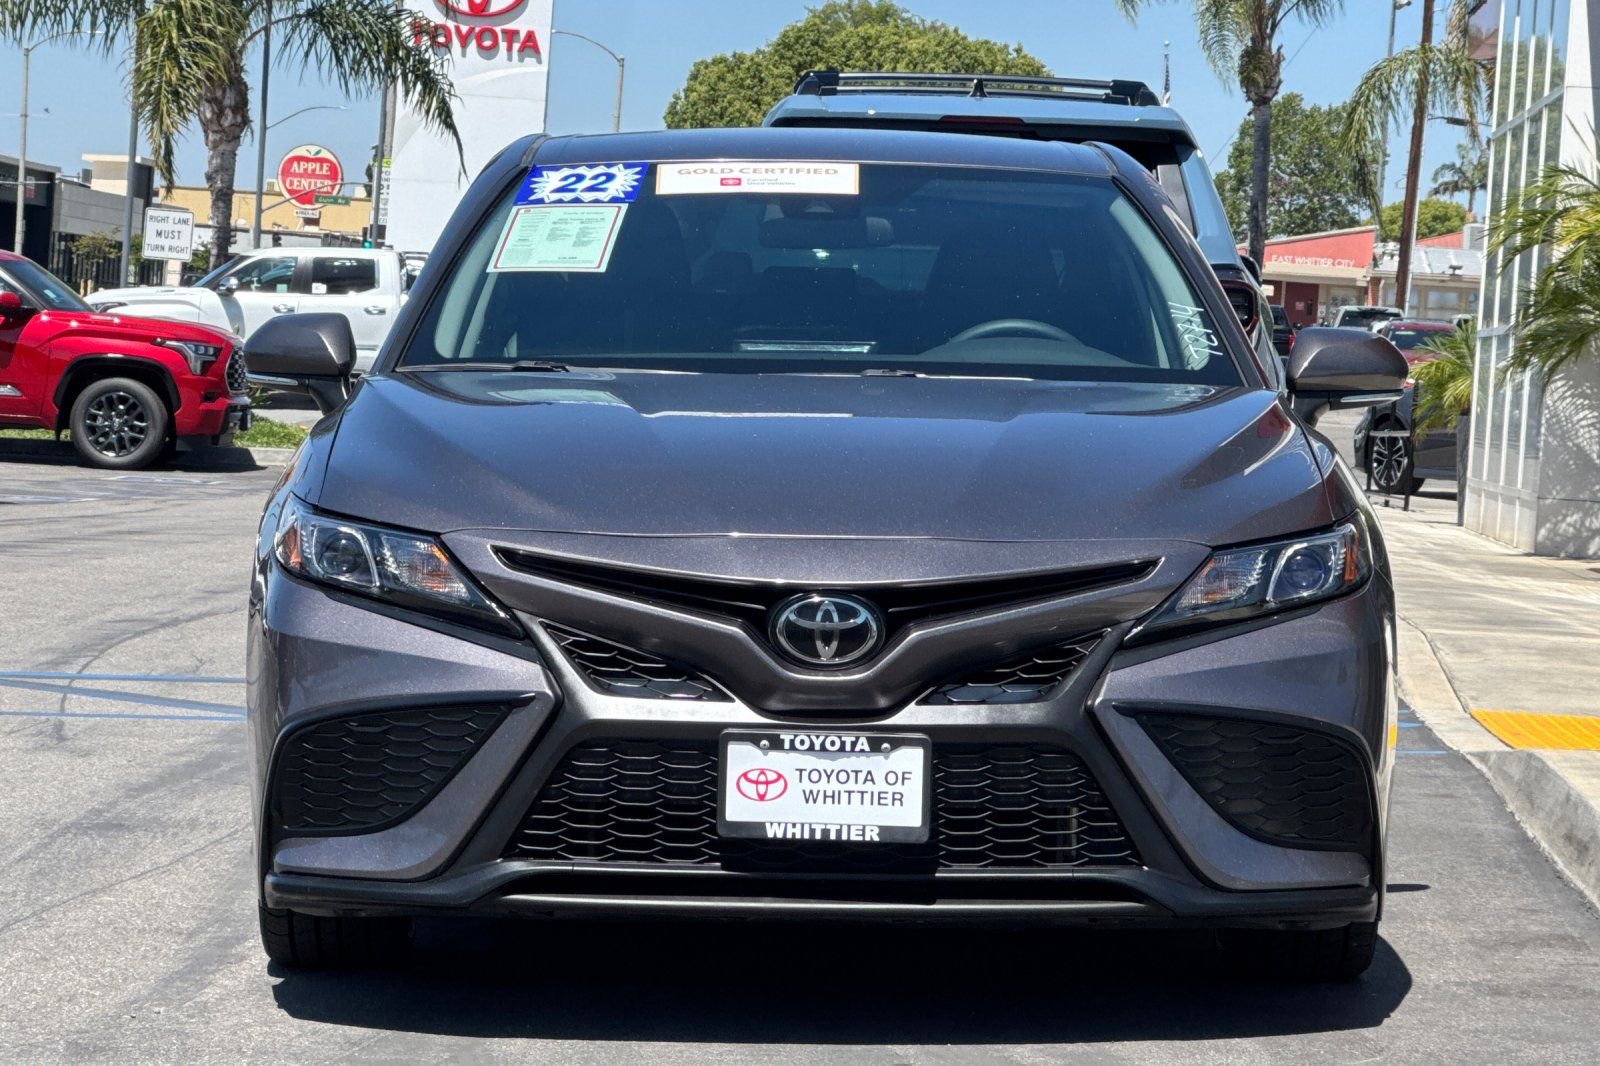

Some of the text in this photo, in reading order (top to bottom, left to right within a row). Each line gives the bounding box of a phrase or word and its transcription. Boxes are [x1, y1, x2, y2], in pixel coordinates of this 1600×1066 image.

[290, 161, 331, 175] APPLE
[677, 167, 839, 175] GOLD CERTIFIED
[286, 177, 333, 192] CENTER
[549, 172, 618, 194] 22
[149, 215, 191, 225] RIGHT LANE
[155, 229, 182, 240] MUST
[146, 243, 189, 254] TURN RIGHT
[1271, 255, 1356, 267] EAST WHITTIER CITY
[780, 734, 871, 752] TOYOTA
[795, 768, 912, 786] TOYOTA OF
[802, 789, 904, 807] WHITTIER
[765, 822, 880, 841] WHITTIER
